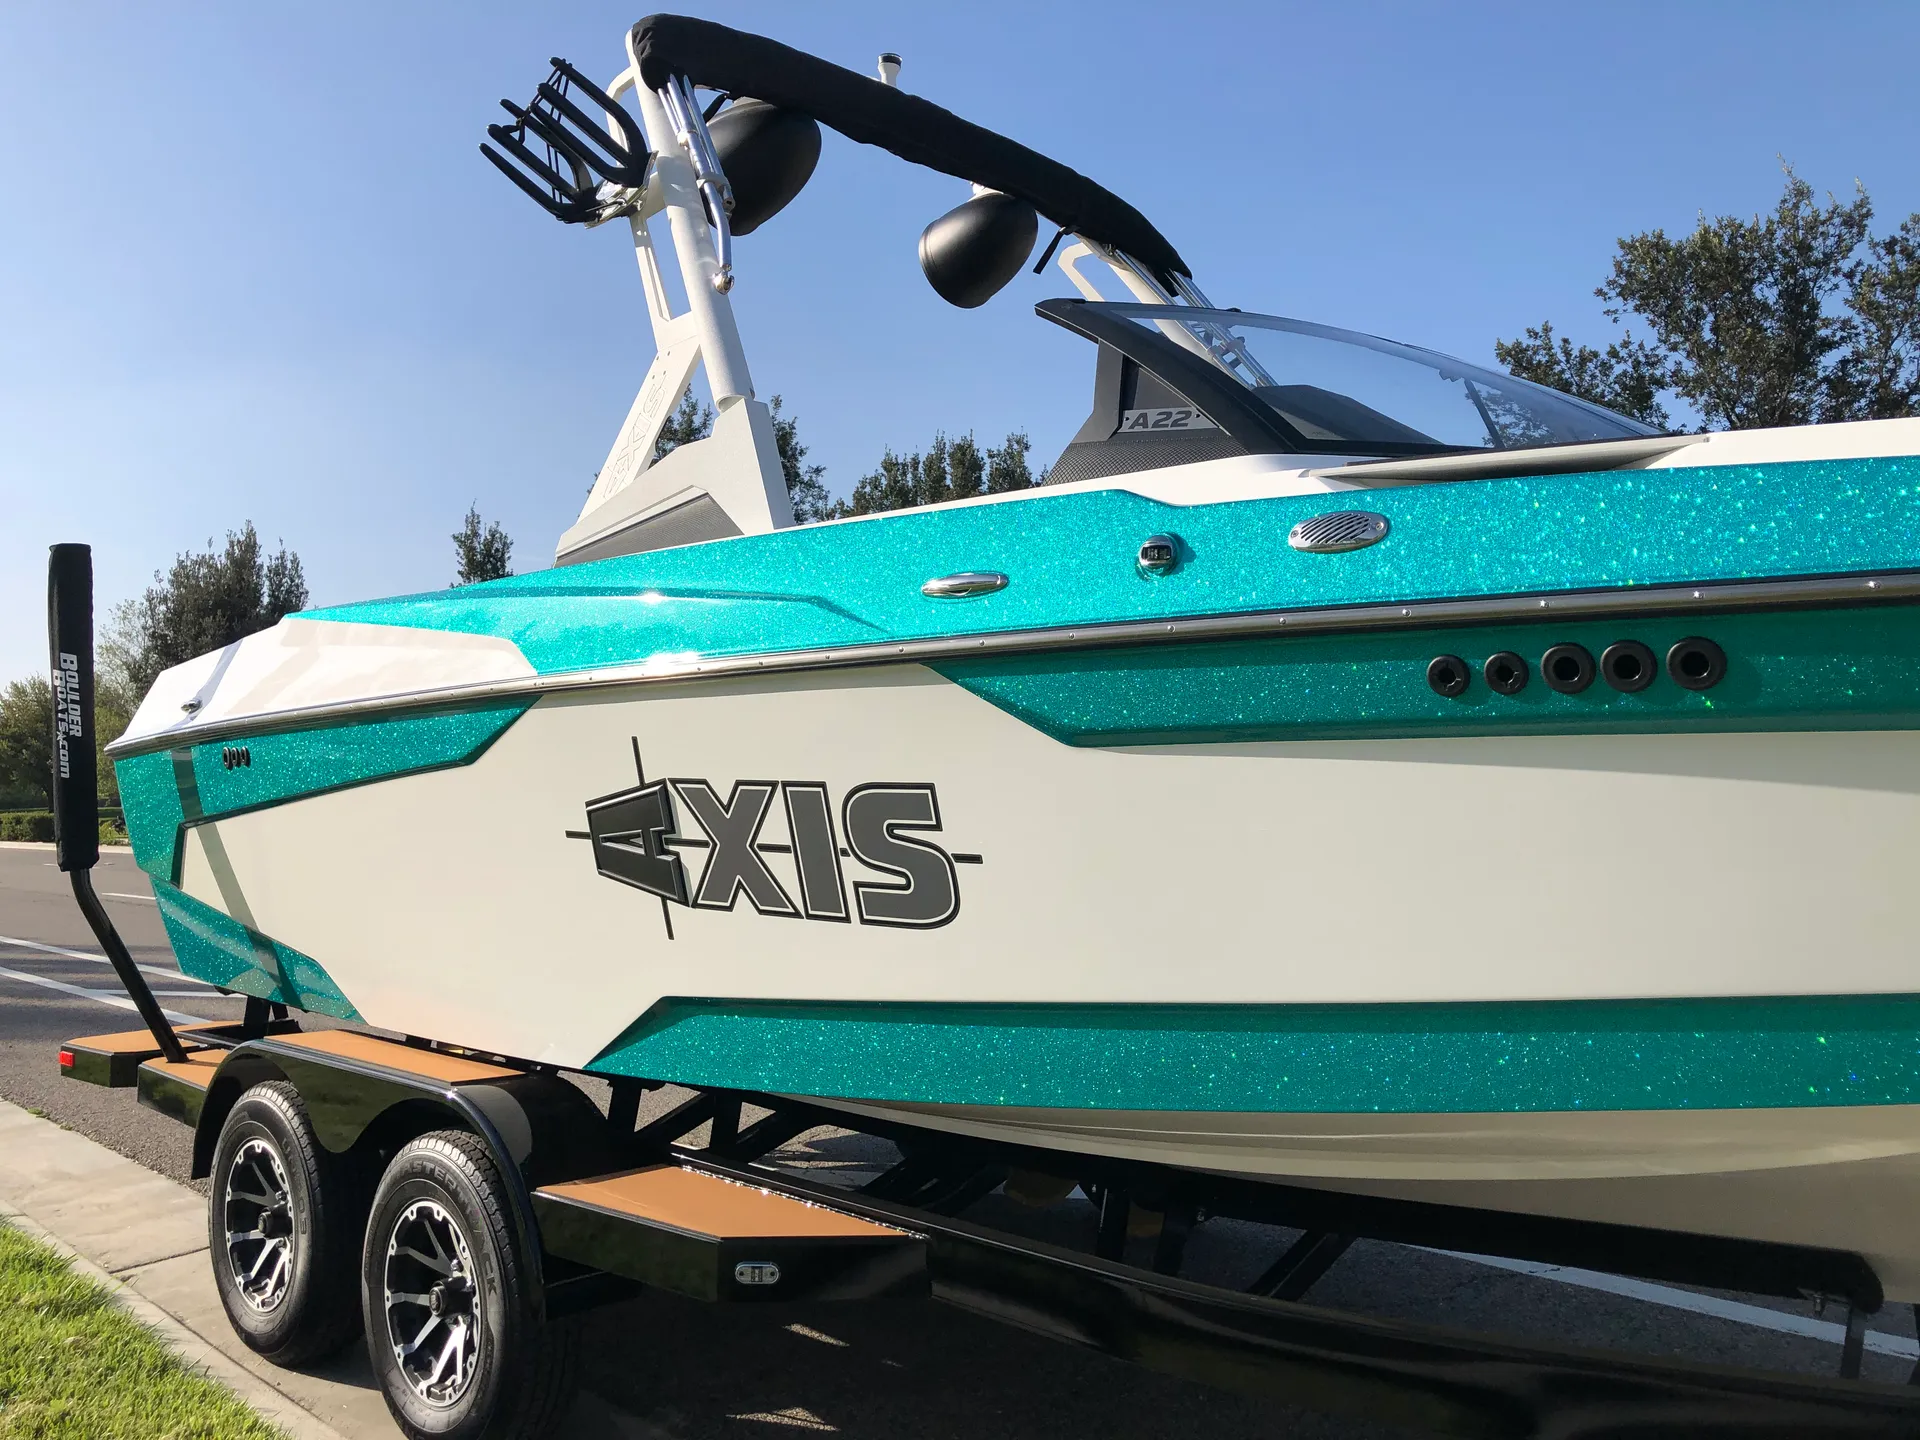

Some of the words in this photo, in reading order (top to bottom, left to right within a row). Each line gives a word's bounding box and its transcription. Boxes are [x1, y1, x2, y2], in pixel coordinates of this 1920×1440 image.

[1128, 411, 1192, 429] A22
[60, 652, 82, 738] BOULDER
[584, 777, 962, 931] AXIS
